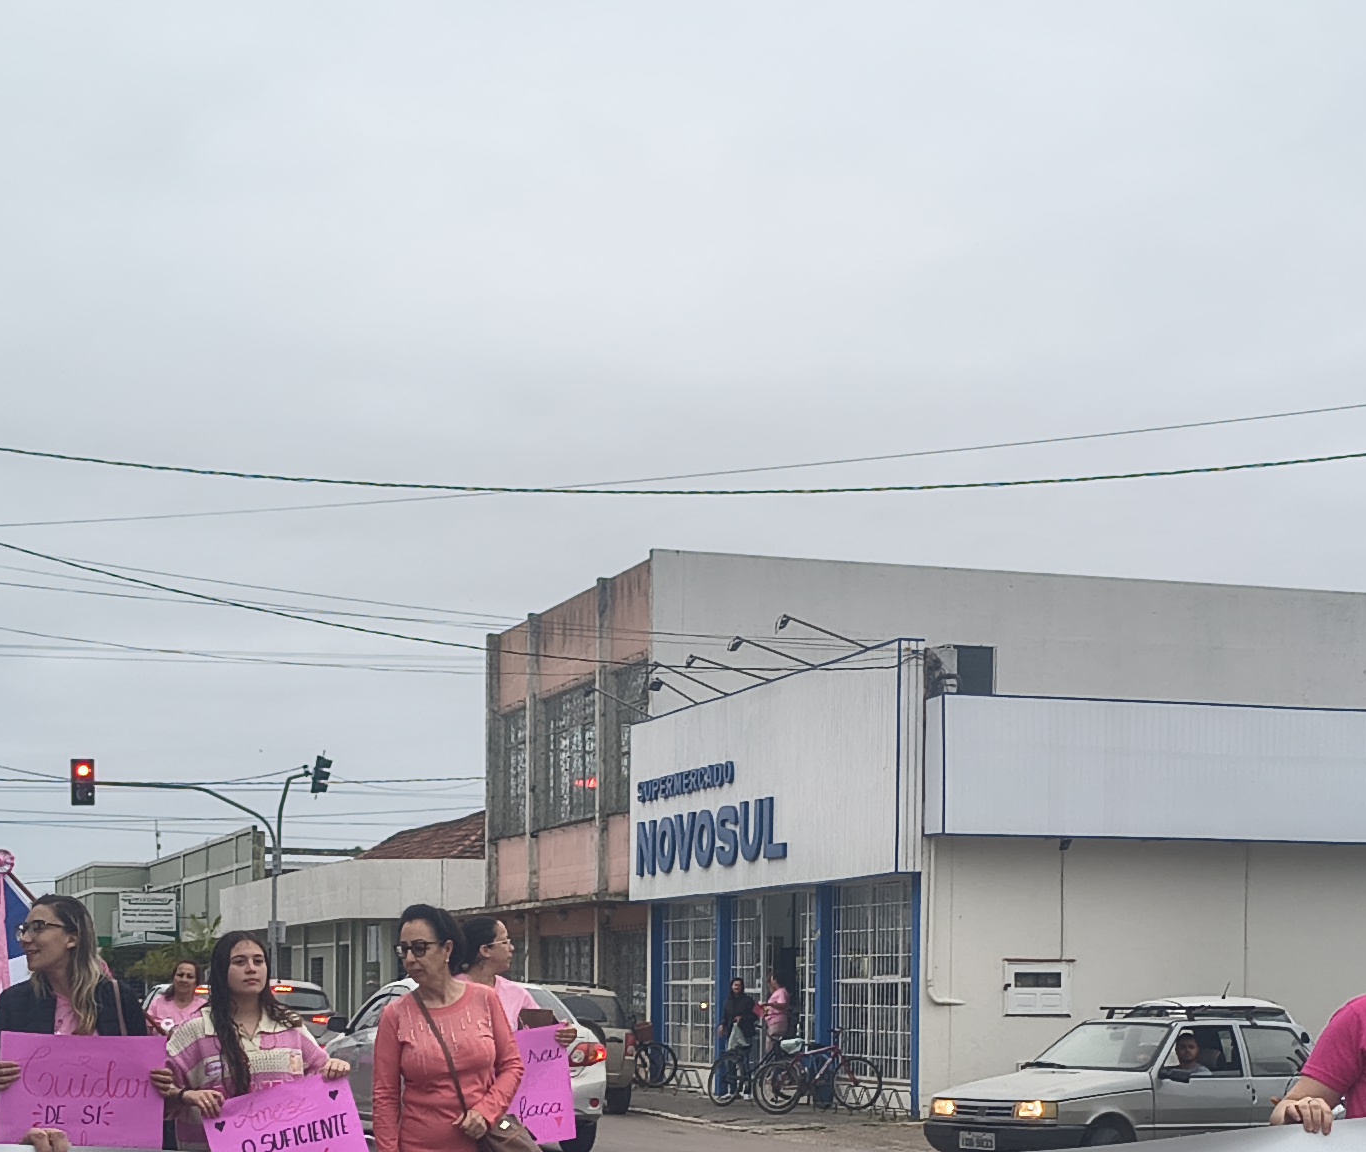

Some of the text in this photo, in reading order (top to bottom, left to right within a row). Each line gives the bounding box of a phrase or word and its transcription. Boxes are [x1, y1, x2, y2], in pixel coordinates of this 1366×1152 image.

[637, 761, 735, 803] SUPERMERCADO
[636, 796, 788, 877] NOVOSUL
[23, 1046, 149, 1099] Cuidar
[44, 1104, 102, 1125] DE SI
[518, 1095, 564, 1123] faça
[260, 1112, 350, 1152] SUFICIENTE
